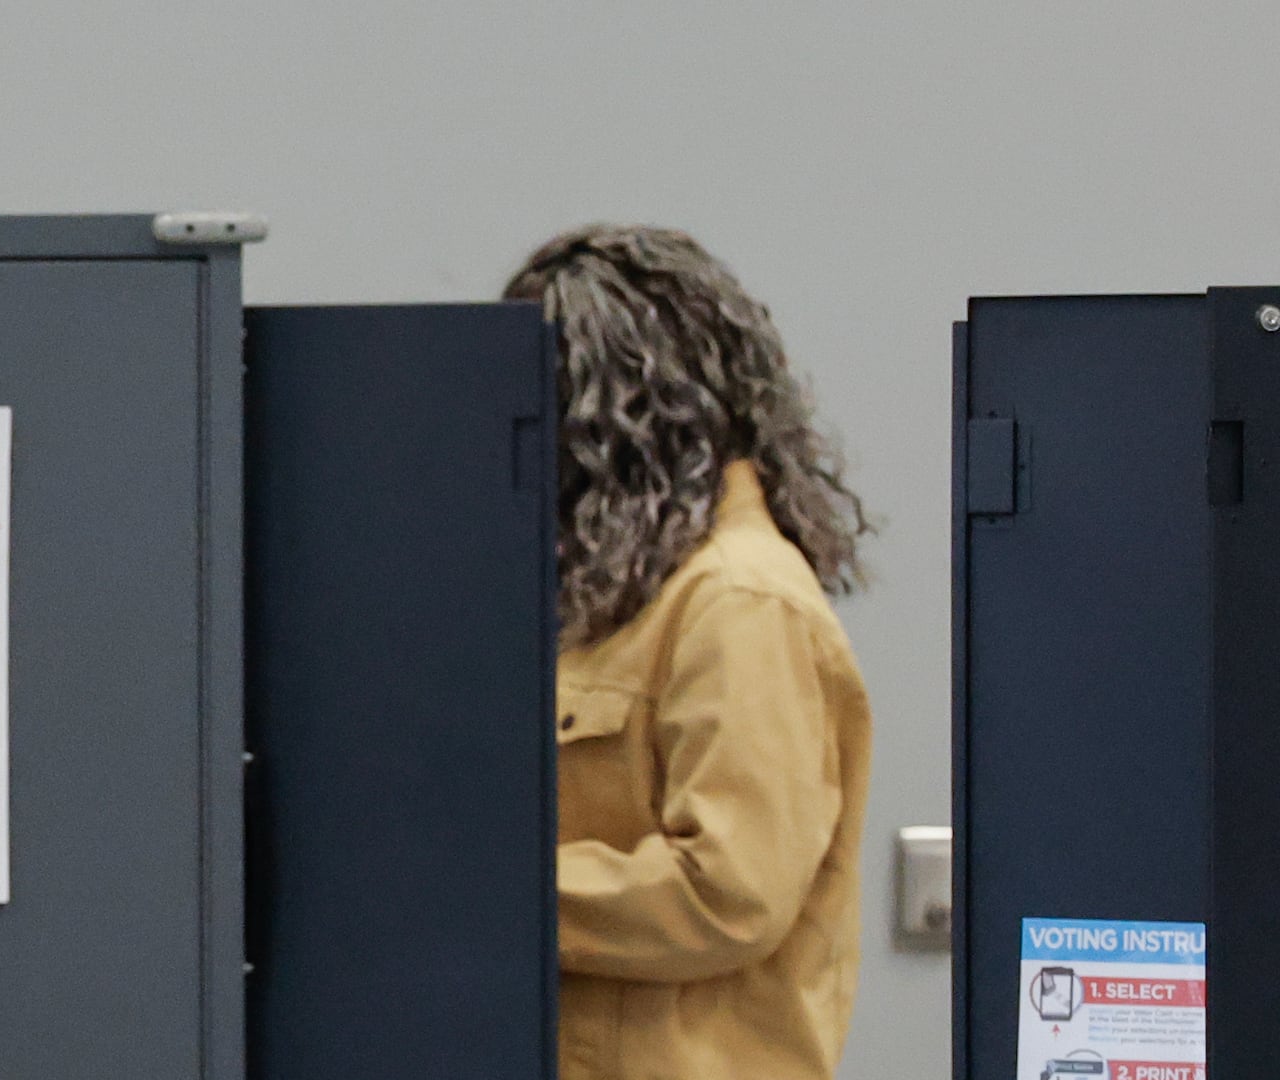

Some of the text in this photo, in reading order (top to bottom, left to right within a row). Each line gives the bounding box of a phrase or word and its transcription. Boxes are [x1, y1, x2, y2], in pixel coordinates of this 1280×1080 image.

[1029, 927, 1117, 951] VOTING
[1090, 982, 1177, 1000] 1. SELECT
